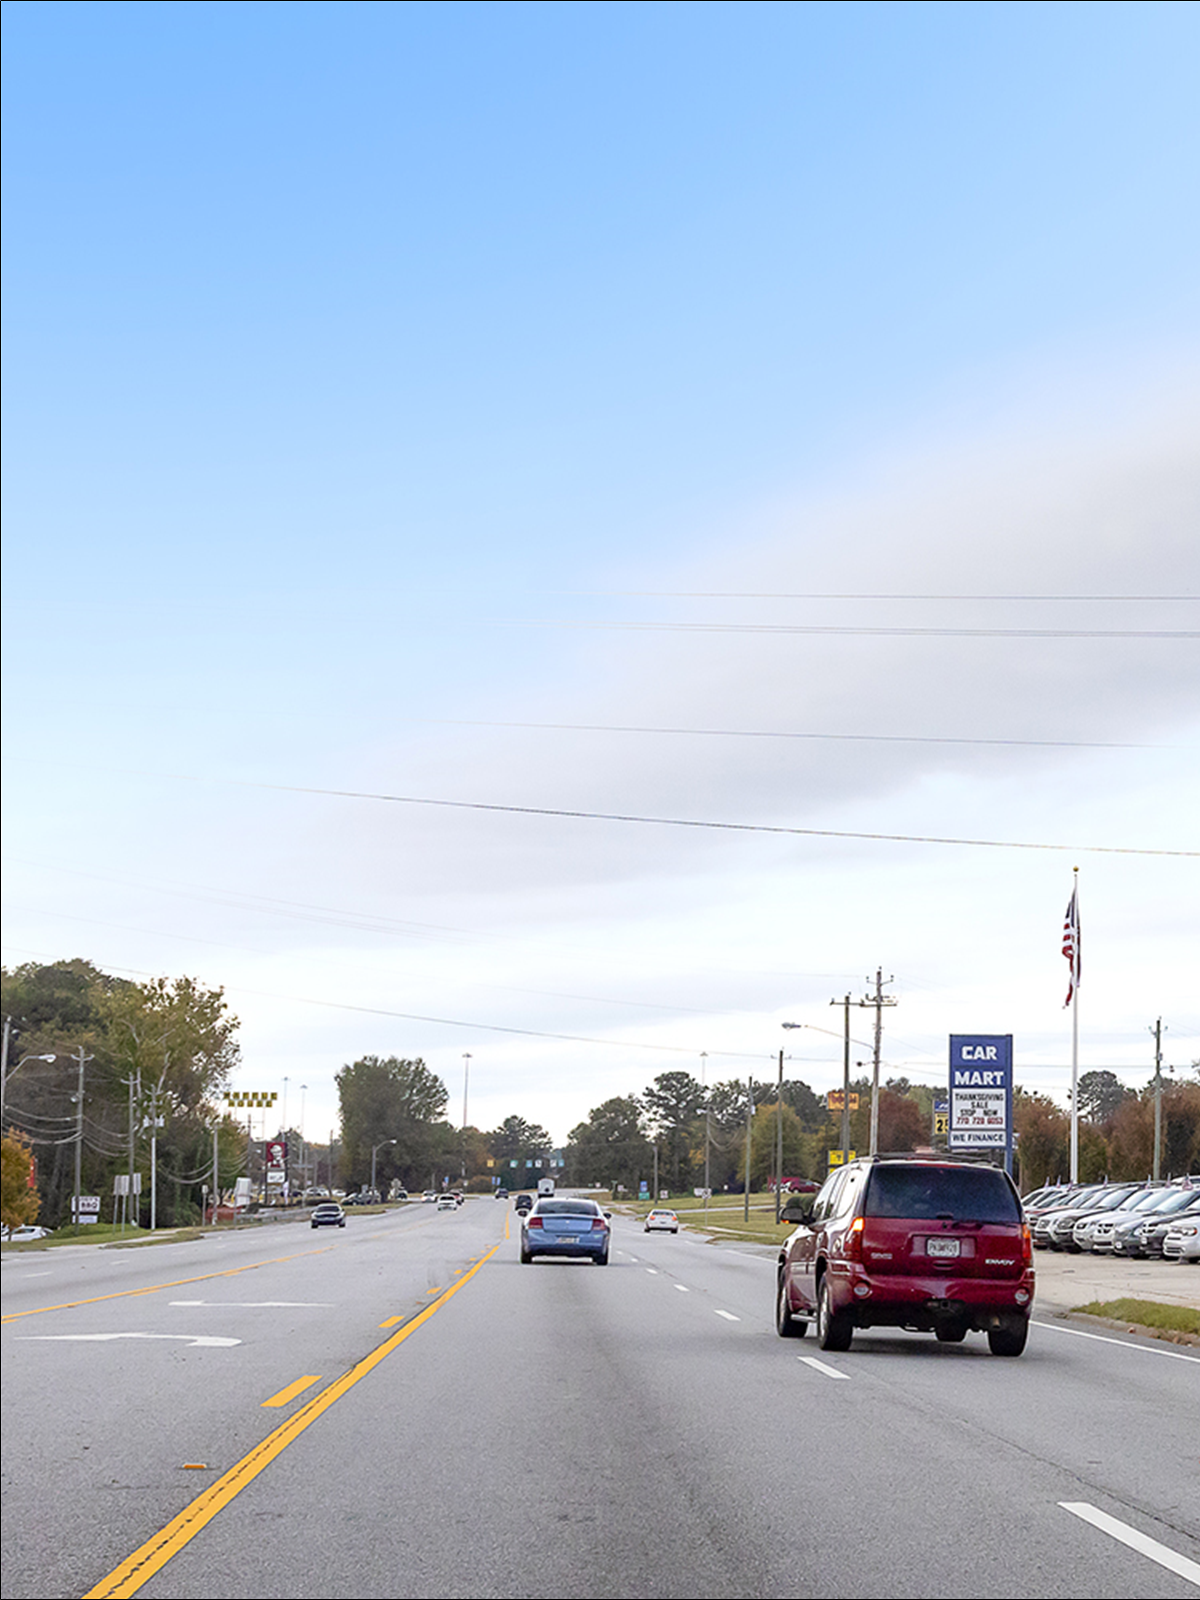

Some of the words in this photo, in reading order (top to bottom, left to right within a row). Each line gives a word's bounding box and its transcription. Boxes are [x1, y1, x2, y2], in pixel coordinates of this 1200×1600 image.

[961, 1046, 998, 1060] CAR
[954, 1071, 1004, 1086] MART
[955, 1093, 1004, 1101] THANKSGIVING
[971, 1101, 988, 1109] SALE
[960, 1109, 976, 1117] STOP
[983, 1109, 998, 1117] NOW
[956, 1117, 970, 1125] 770
[953, 1134, 966, 1142] WE
[968, 1134, 1004, 1142] FINANCE
